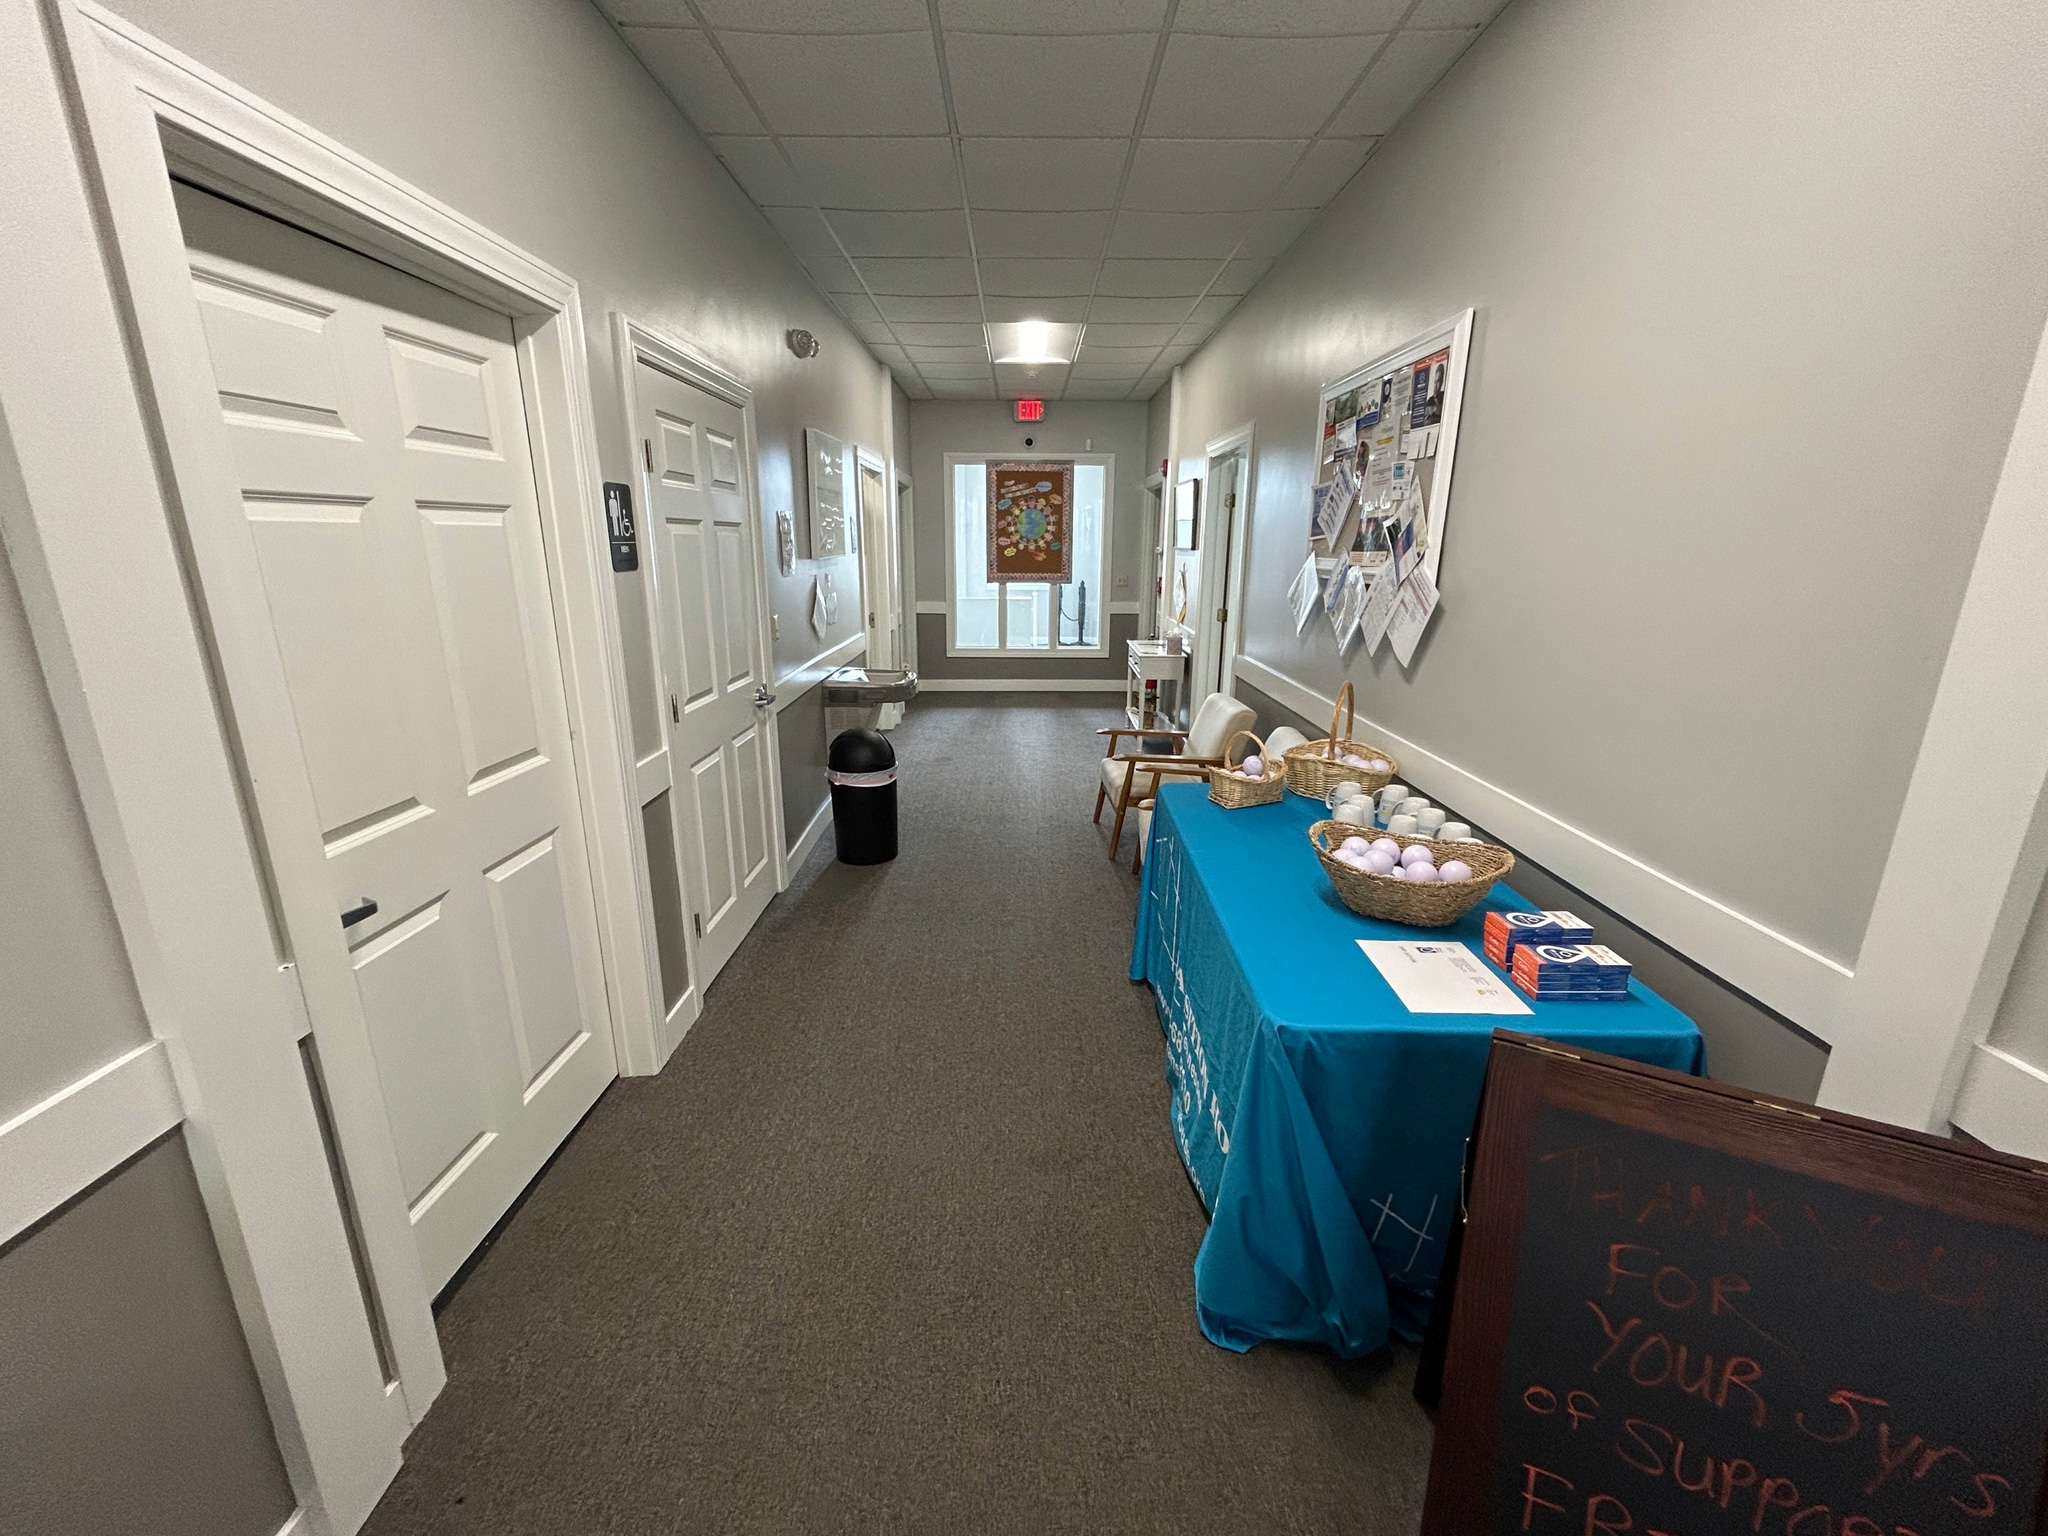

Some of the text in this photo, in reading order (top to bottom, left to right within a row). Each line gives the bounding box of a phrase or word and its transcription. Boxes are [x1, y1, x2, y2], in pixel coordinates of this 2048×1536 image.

[1018, 400, 1041, 420] EXIT
[1606, 1243, 1762, 1330] FOR
[1587, 1299, 1767, 1428] YOUR
